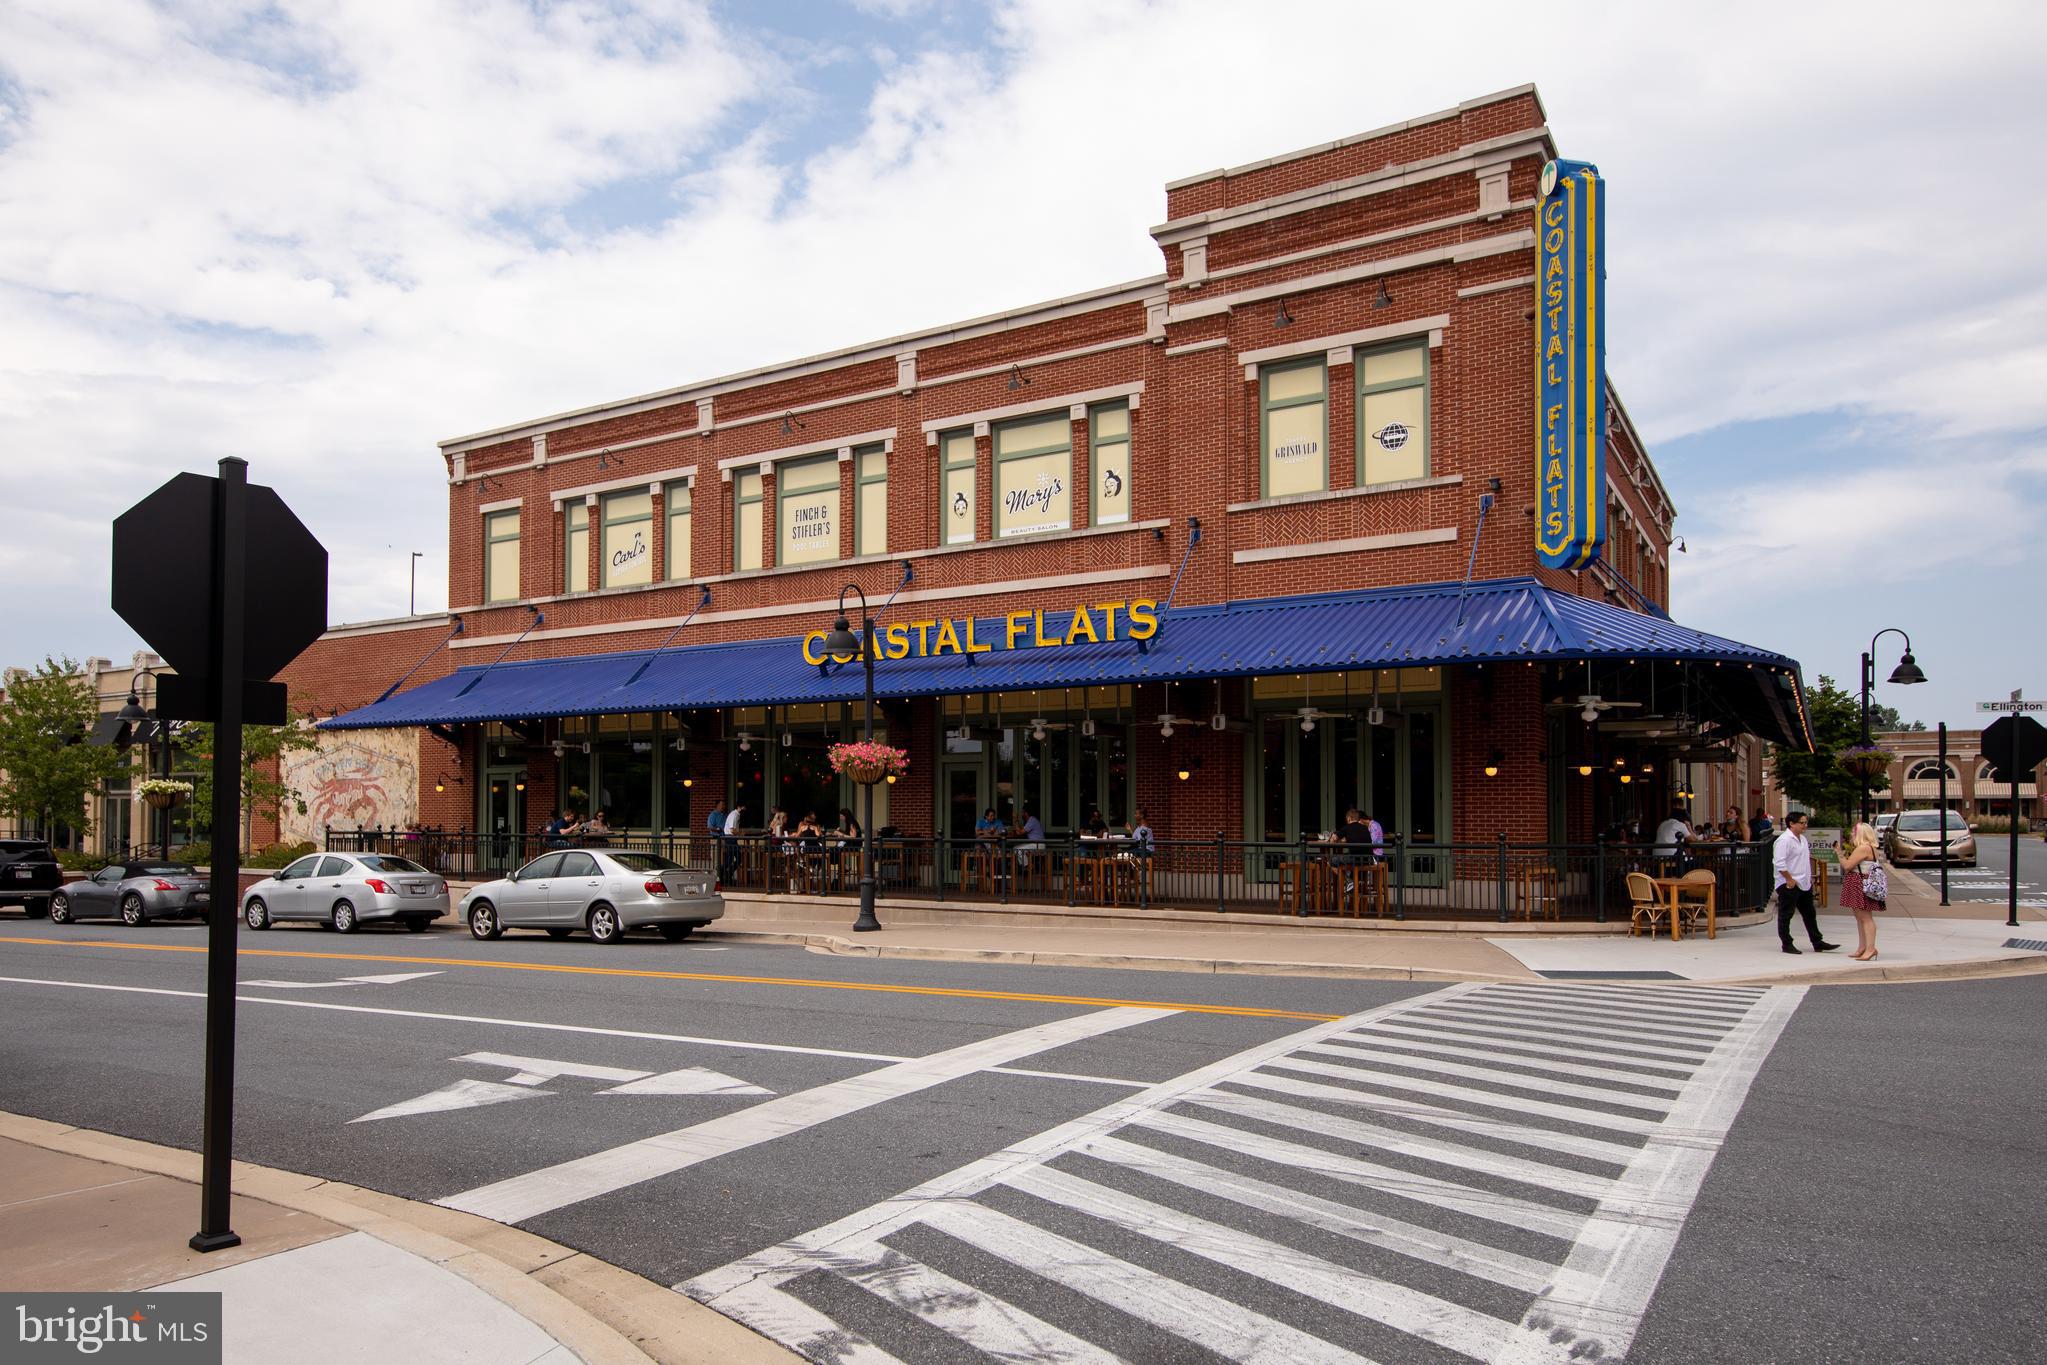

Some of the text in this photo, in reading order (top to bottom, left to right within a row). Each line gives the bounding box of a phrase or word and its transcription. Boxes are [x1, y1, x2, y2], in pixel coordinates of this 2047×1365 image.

[1545, 200, 1564, 536] COASTAL FLATS
[1005, 478, 1063, 514] Mary's
[795, 505, 827, 522] FINCH &
[792, 522, 831, 540] STIFLER'S
[1010, 527, 1035, 535] BEAUTY
[612, 540, 646, 567] Carl's
[1006, 599, 1159, 649] FLATS
[1991, 702, 2043, 712] Ellington
